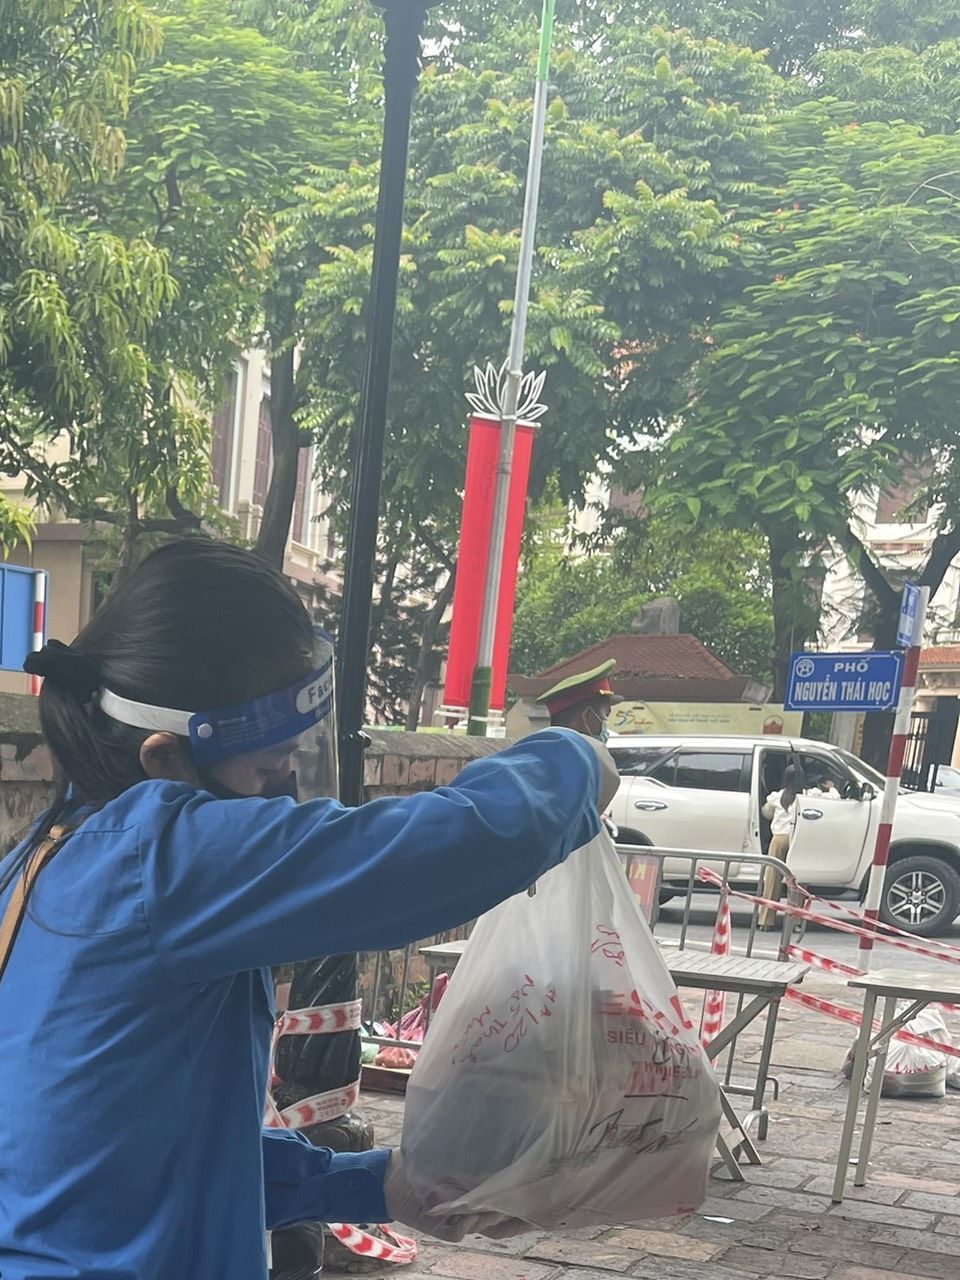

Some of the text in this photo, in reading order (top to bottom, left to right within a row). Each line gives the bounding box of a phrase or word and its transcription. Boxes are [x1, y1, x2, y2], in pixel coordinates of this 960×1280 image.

[834, 658, 871, 673] PHỐ
[794, 674, 891, 705] NGUYỄN THÁI HỌC
